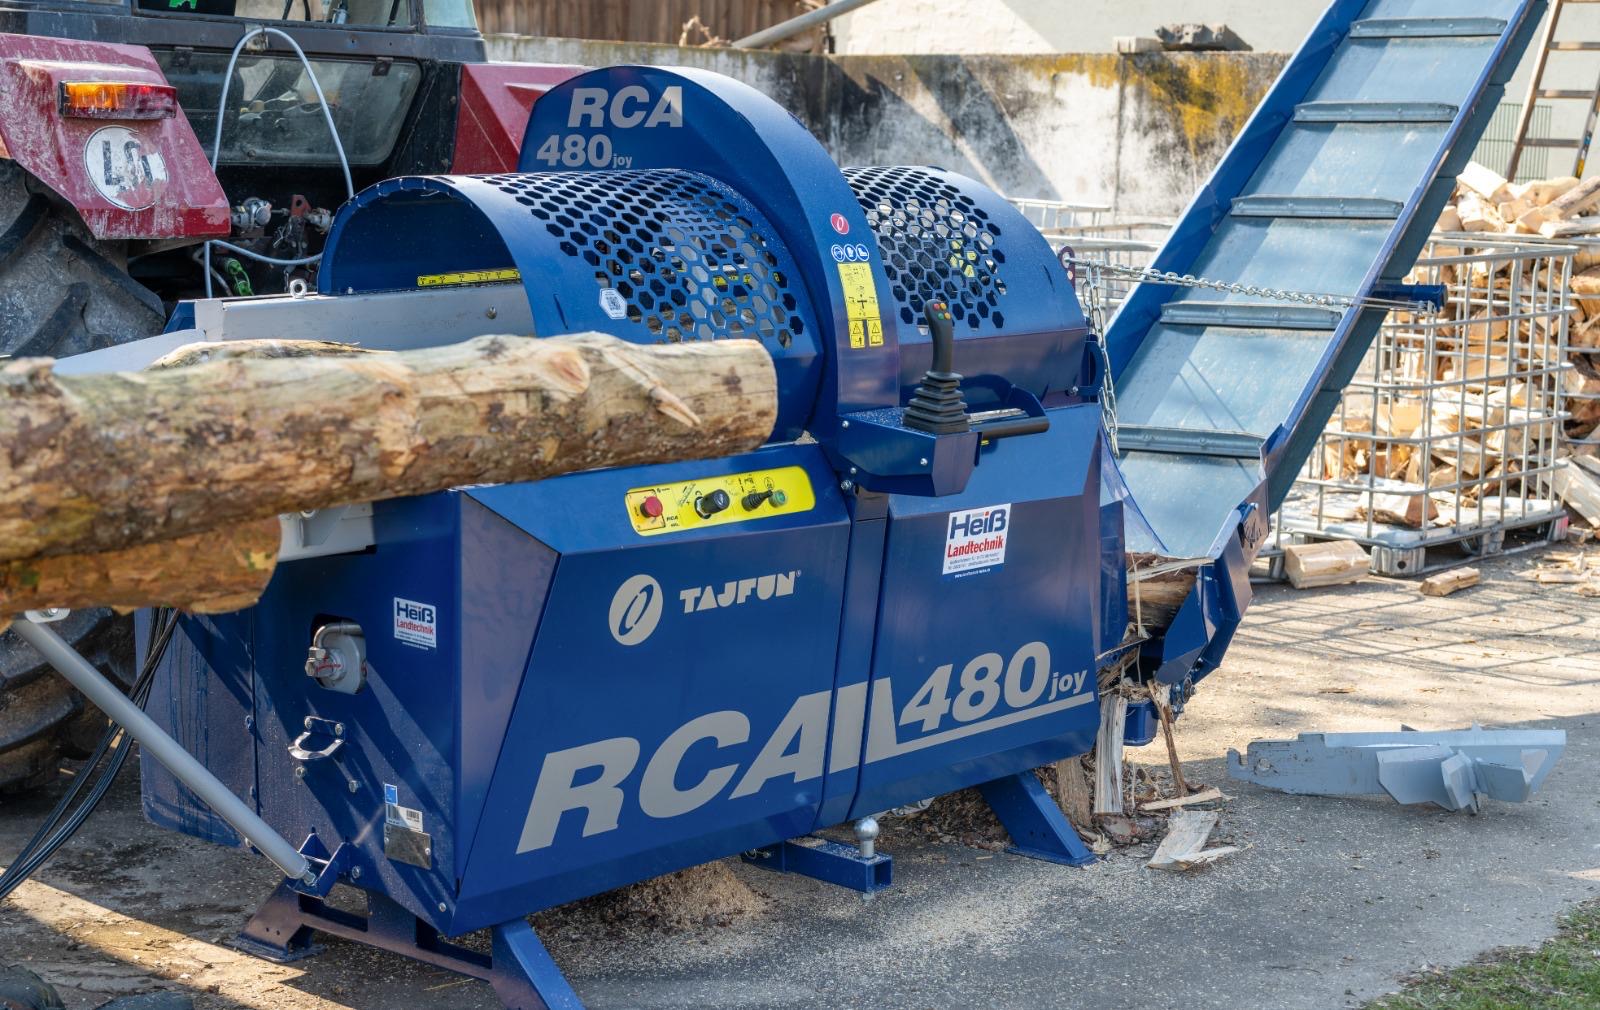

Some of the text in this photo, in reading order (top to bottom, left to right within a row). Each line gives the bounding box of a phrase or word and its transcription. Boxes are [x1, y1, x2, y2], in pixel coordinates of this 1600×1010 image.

[567, 85, 683, 129] RCA
[536, 133, 633, 168] 480 joy
[947, 535, 1004, 558] Landtechnik
[396, 617, 434, 636] Landtechnik
[515, 641, 1088, 855] RCA 480 joy
